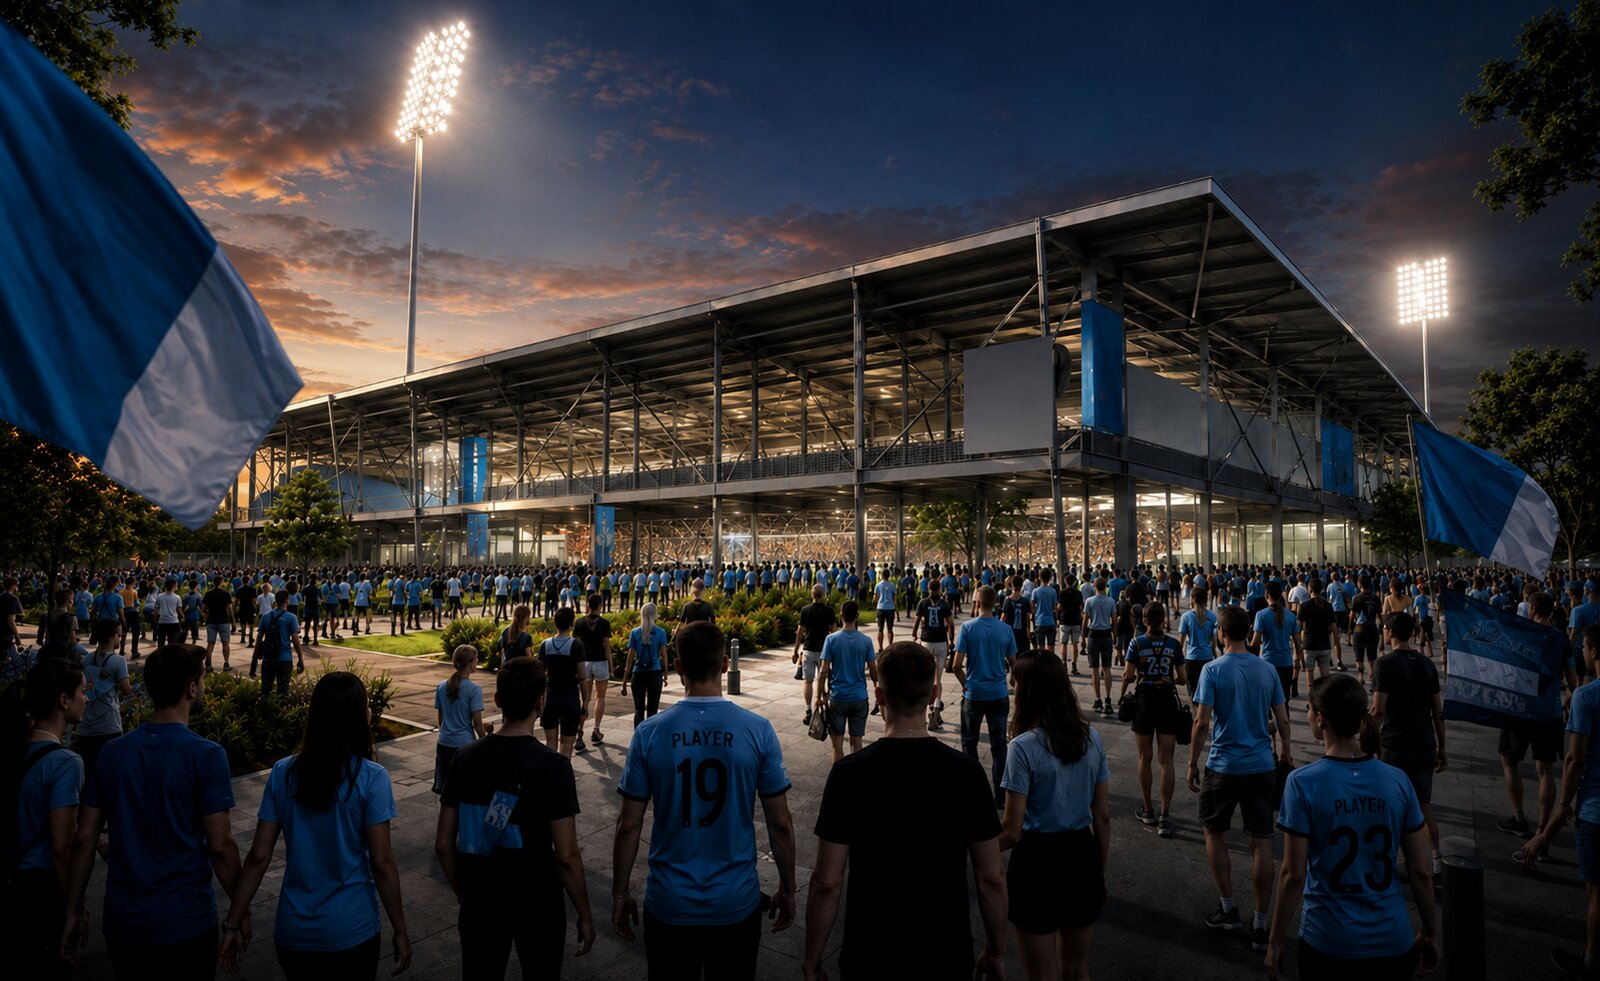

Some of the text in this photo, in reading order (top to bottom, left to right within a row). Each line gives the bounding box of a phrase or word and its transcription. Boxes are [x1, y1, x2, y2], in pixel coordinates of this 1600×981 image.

[672, 731, 734, 749] PLAYER
[677, 758, 727, 828] 19
[1334, 797, 1386, 814] PLAYER
[1329, 825, 1392, 893] 23
